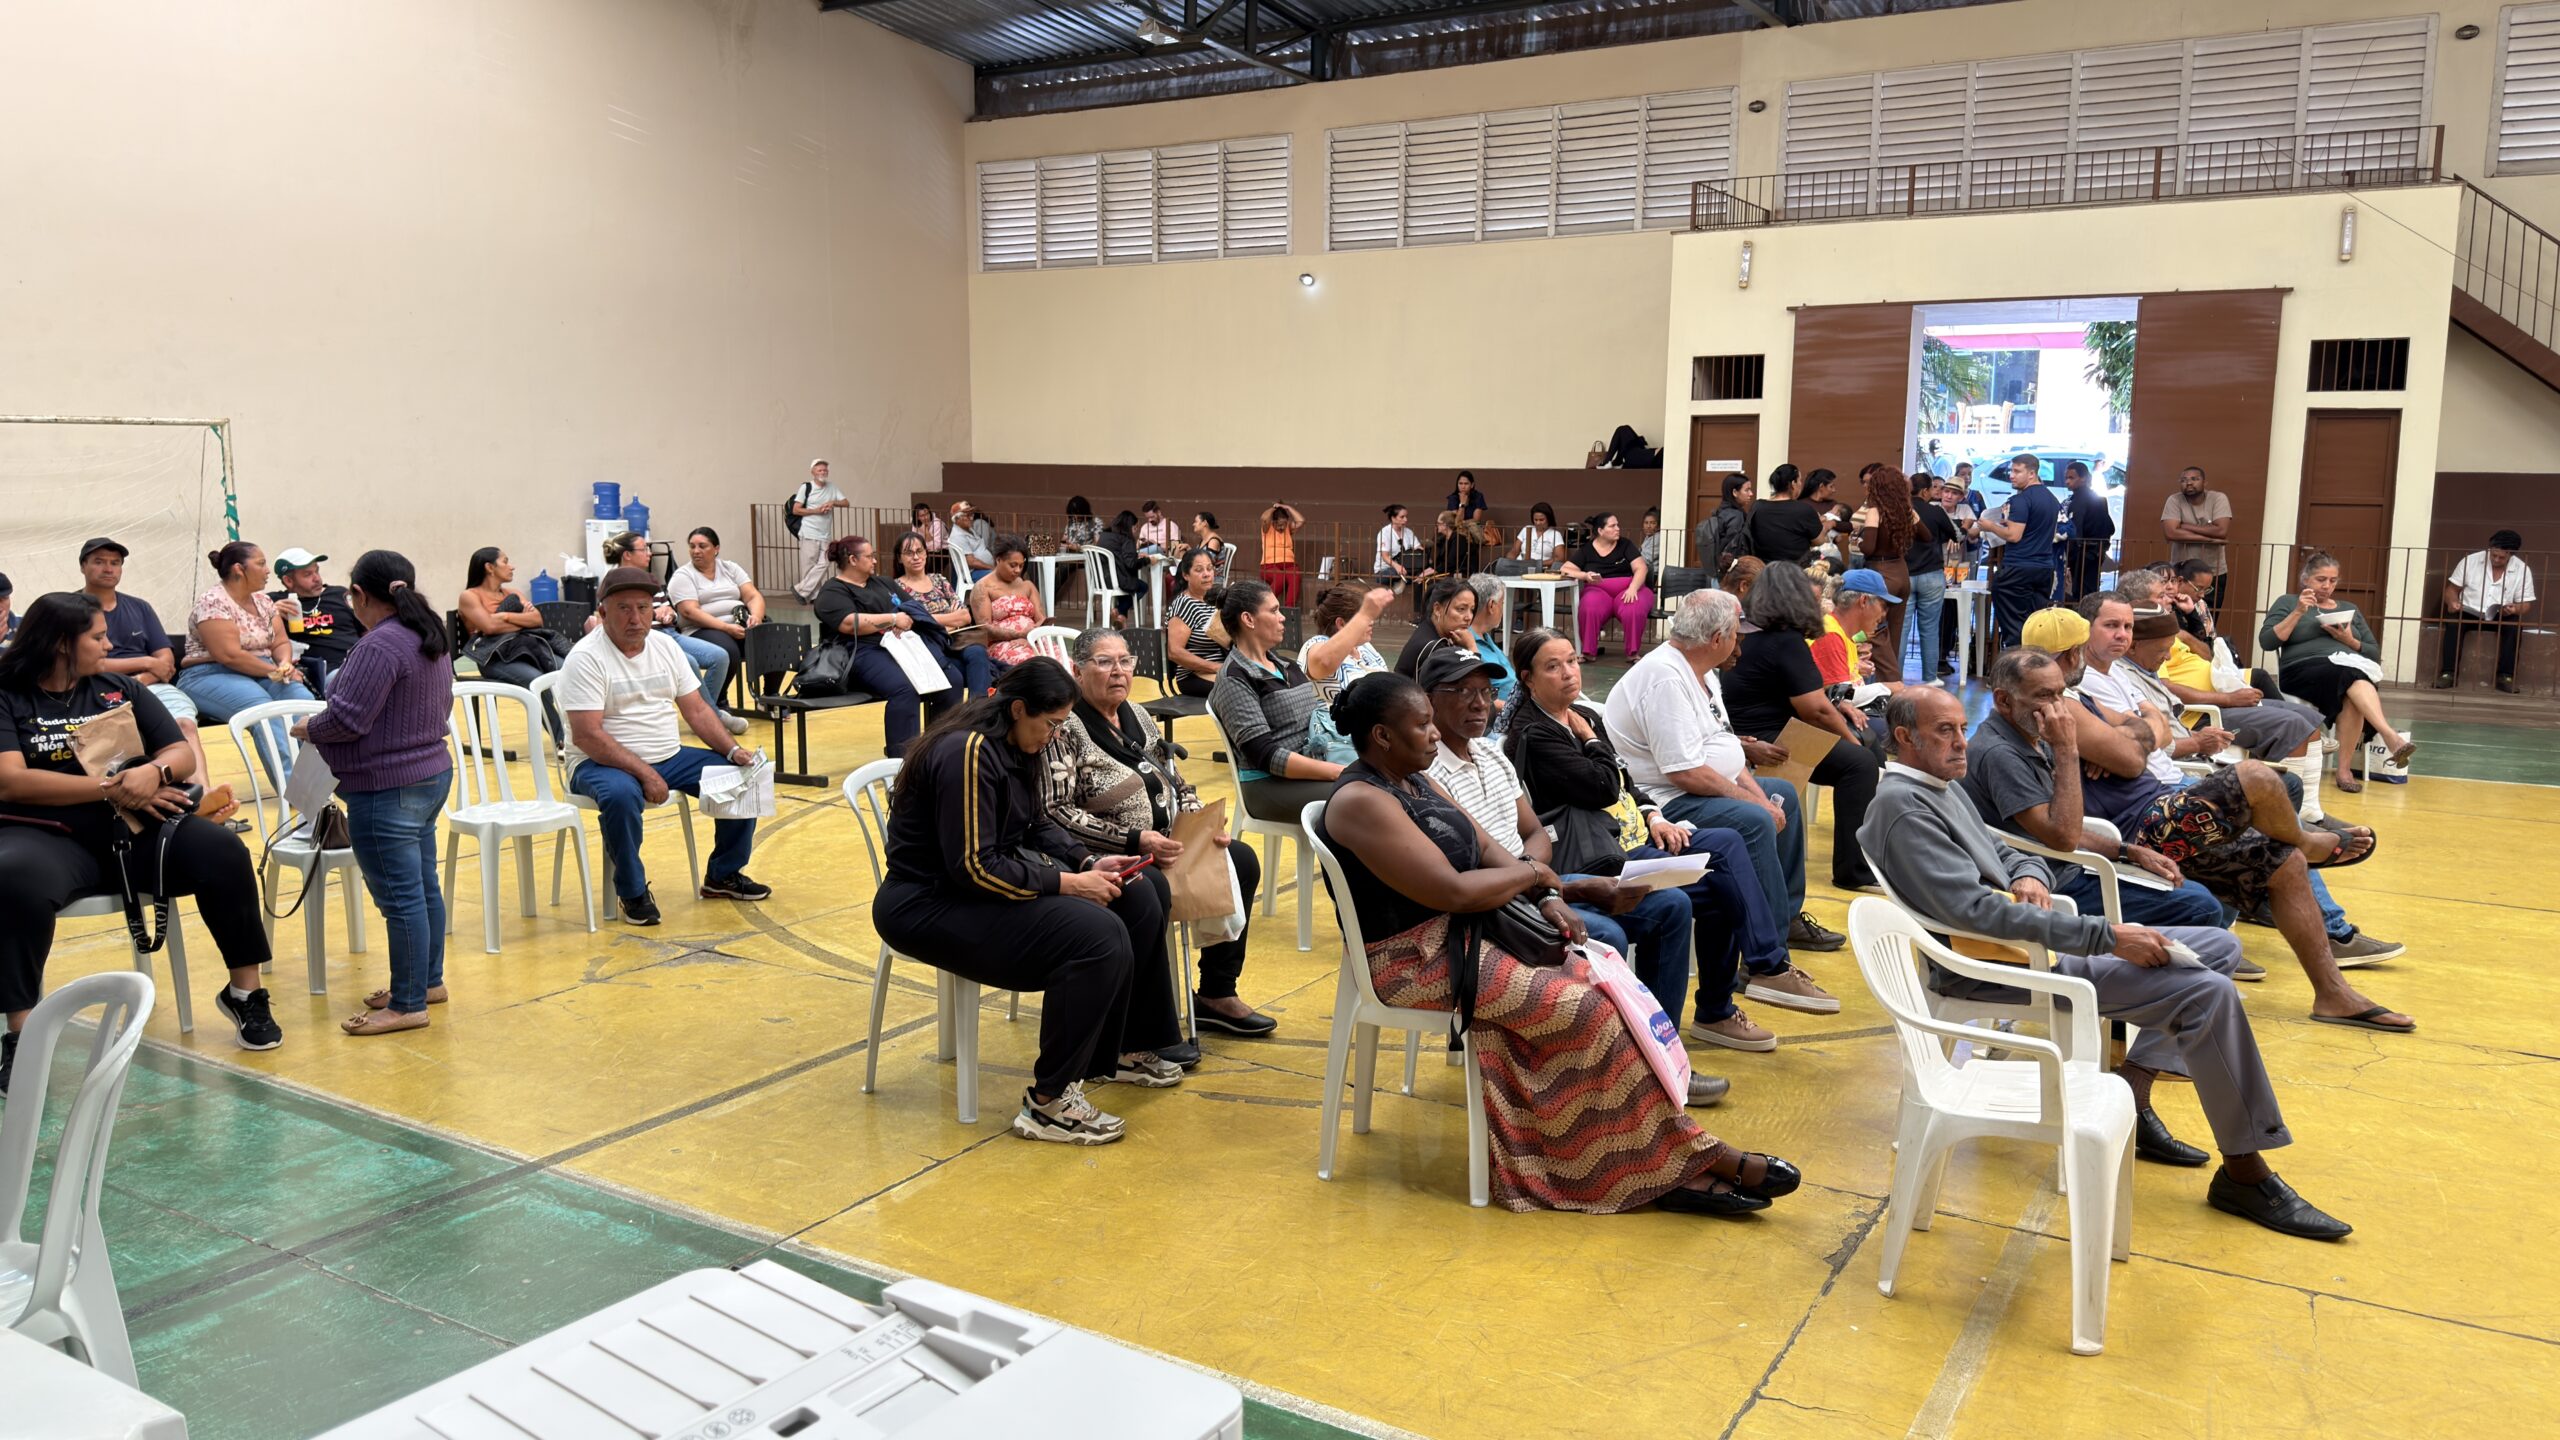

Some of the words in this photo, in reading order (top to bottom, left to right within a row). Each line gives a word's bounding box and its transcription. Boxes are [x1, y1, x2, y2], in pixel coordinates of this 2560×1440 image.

[37, 717, 68, 726] Cada
[30, 733, 47, 743] de
[38, 740, 65, 752] Nós
